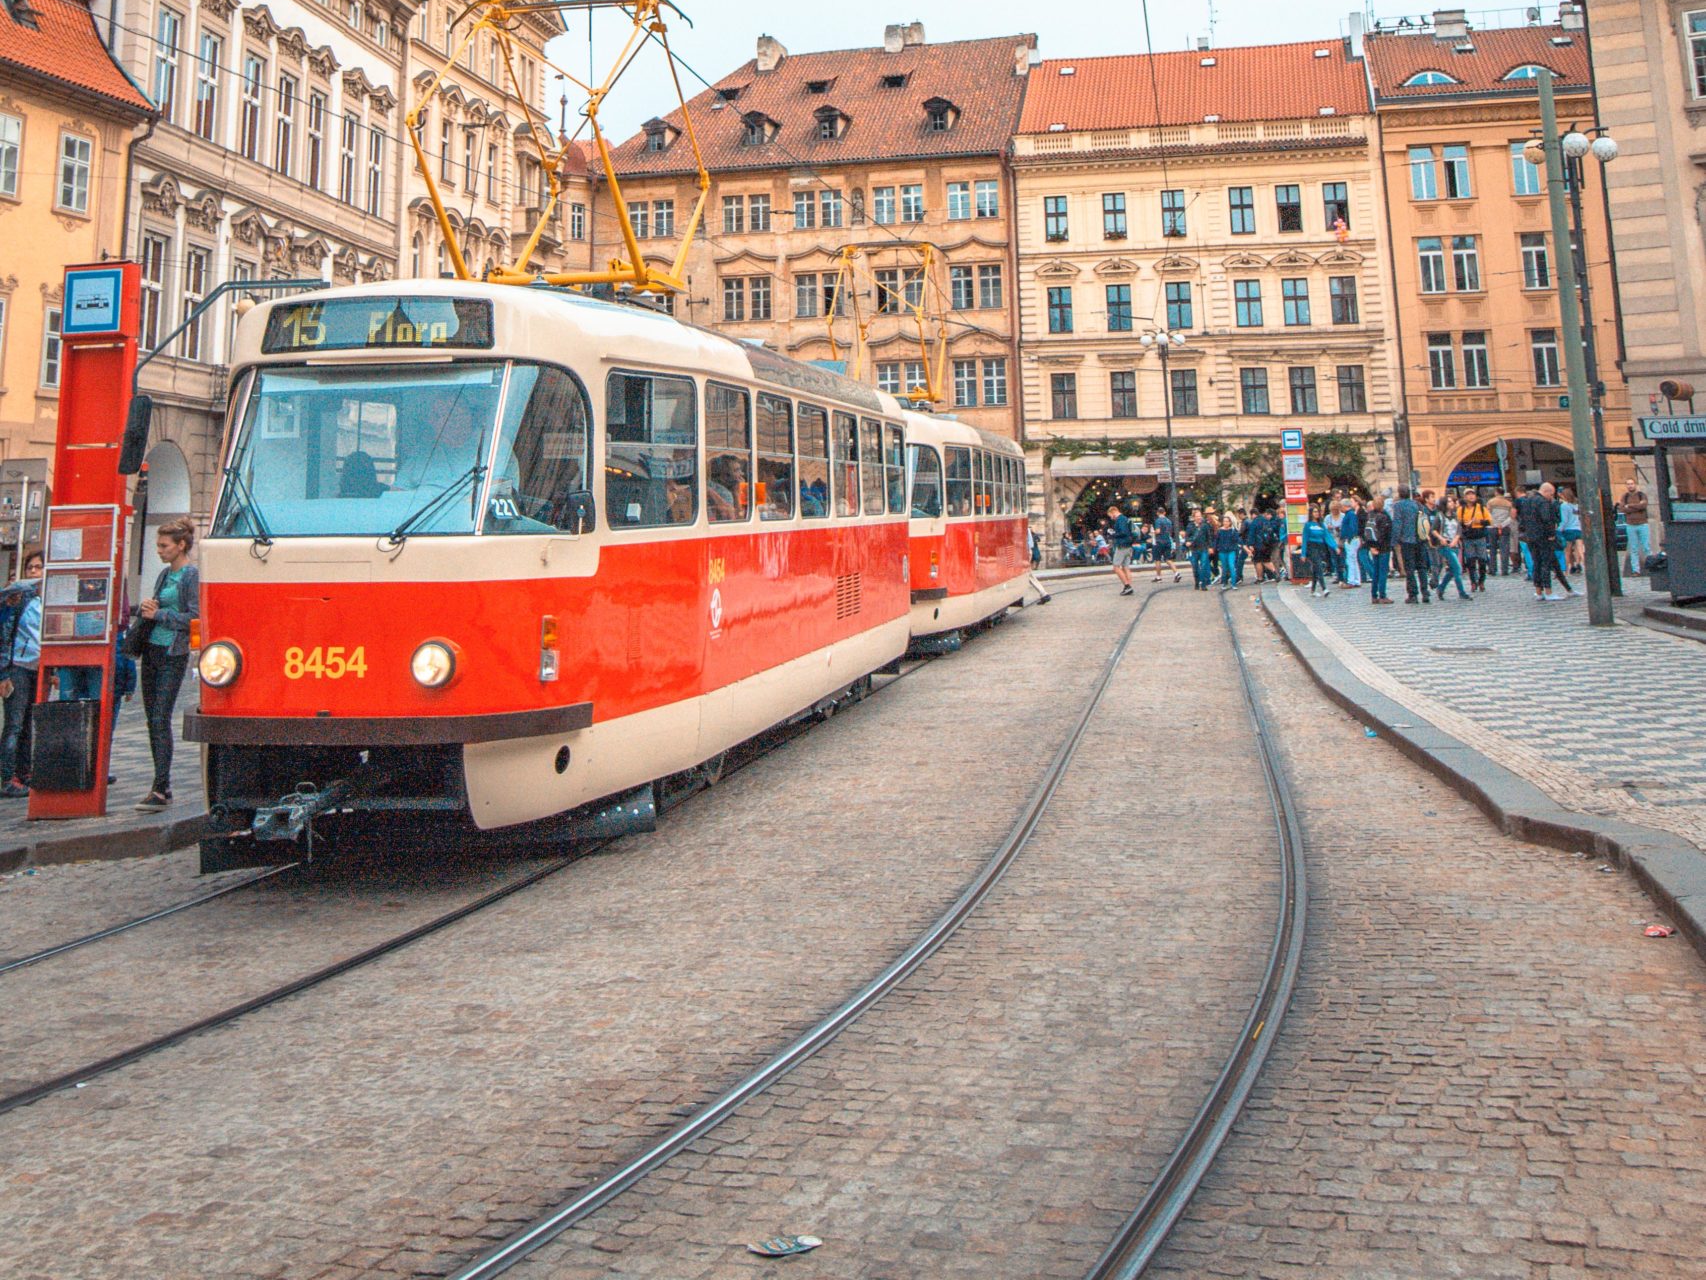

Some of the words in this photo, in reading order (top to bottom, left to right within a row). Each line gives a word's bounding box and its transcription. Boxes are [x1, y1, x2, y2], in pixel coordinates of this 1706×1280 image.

[283, 306, 327, 347] 15
[368, 310, 448, 343] Flora
[1649, 421, 1680, 434] Cold
[1684, 420, 1706, 433] drin
[490, 498, 520, 517] 221
[284, 646, 368, 679] 8454
